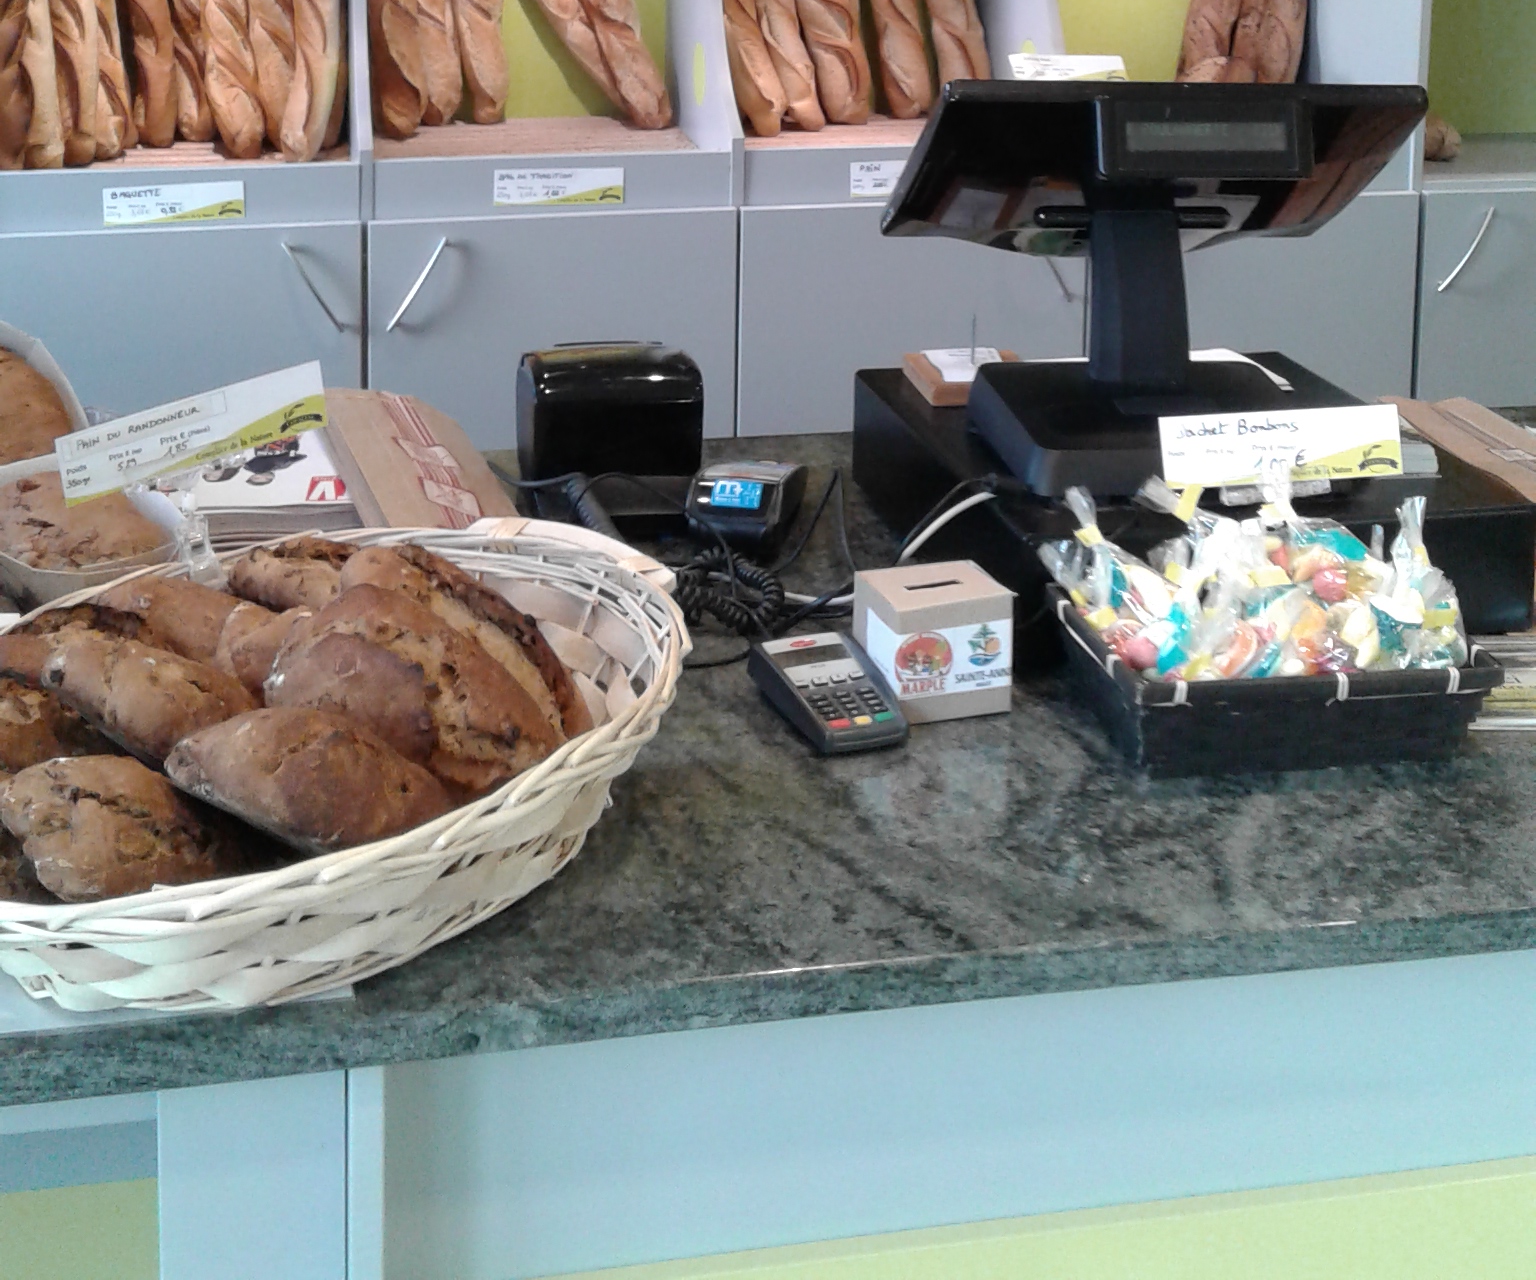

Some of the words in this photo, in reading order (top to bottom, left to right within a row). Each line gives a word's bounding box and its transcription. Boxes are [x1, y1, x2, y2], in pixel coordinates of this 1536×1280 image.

[110, 188, 162, 200] BAGUETTE
[76, 436, 101, 451] PAIN
[106, 430, 122, 442] DU
[127, 406, 201, 435] RANDONNEUR
[954, 666, 1012, 684] SAINTE-ANN
